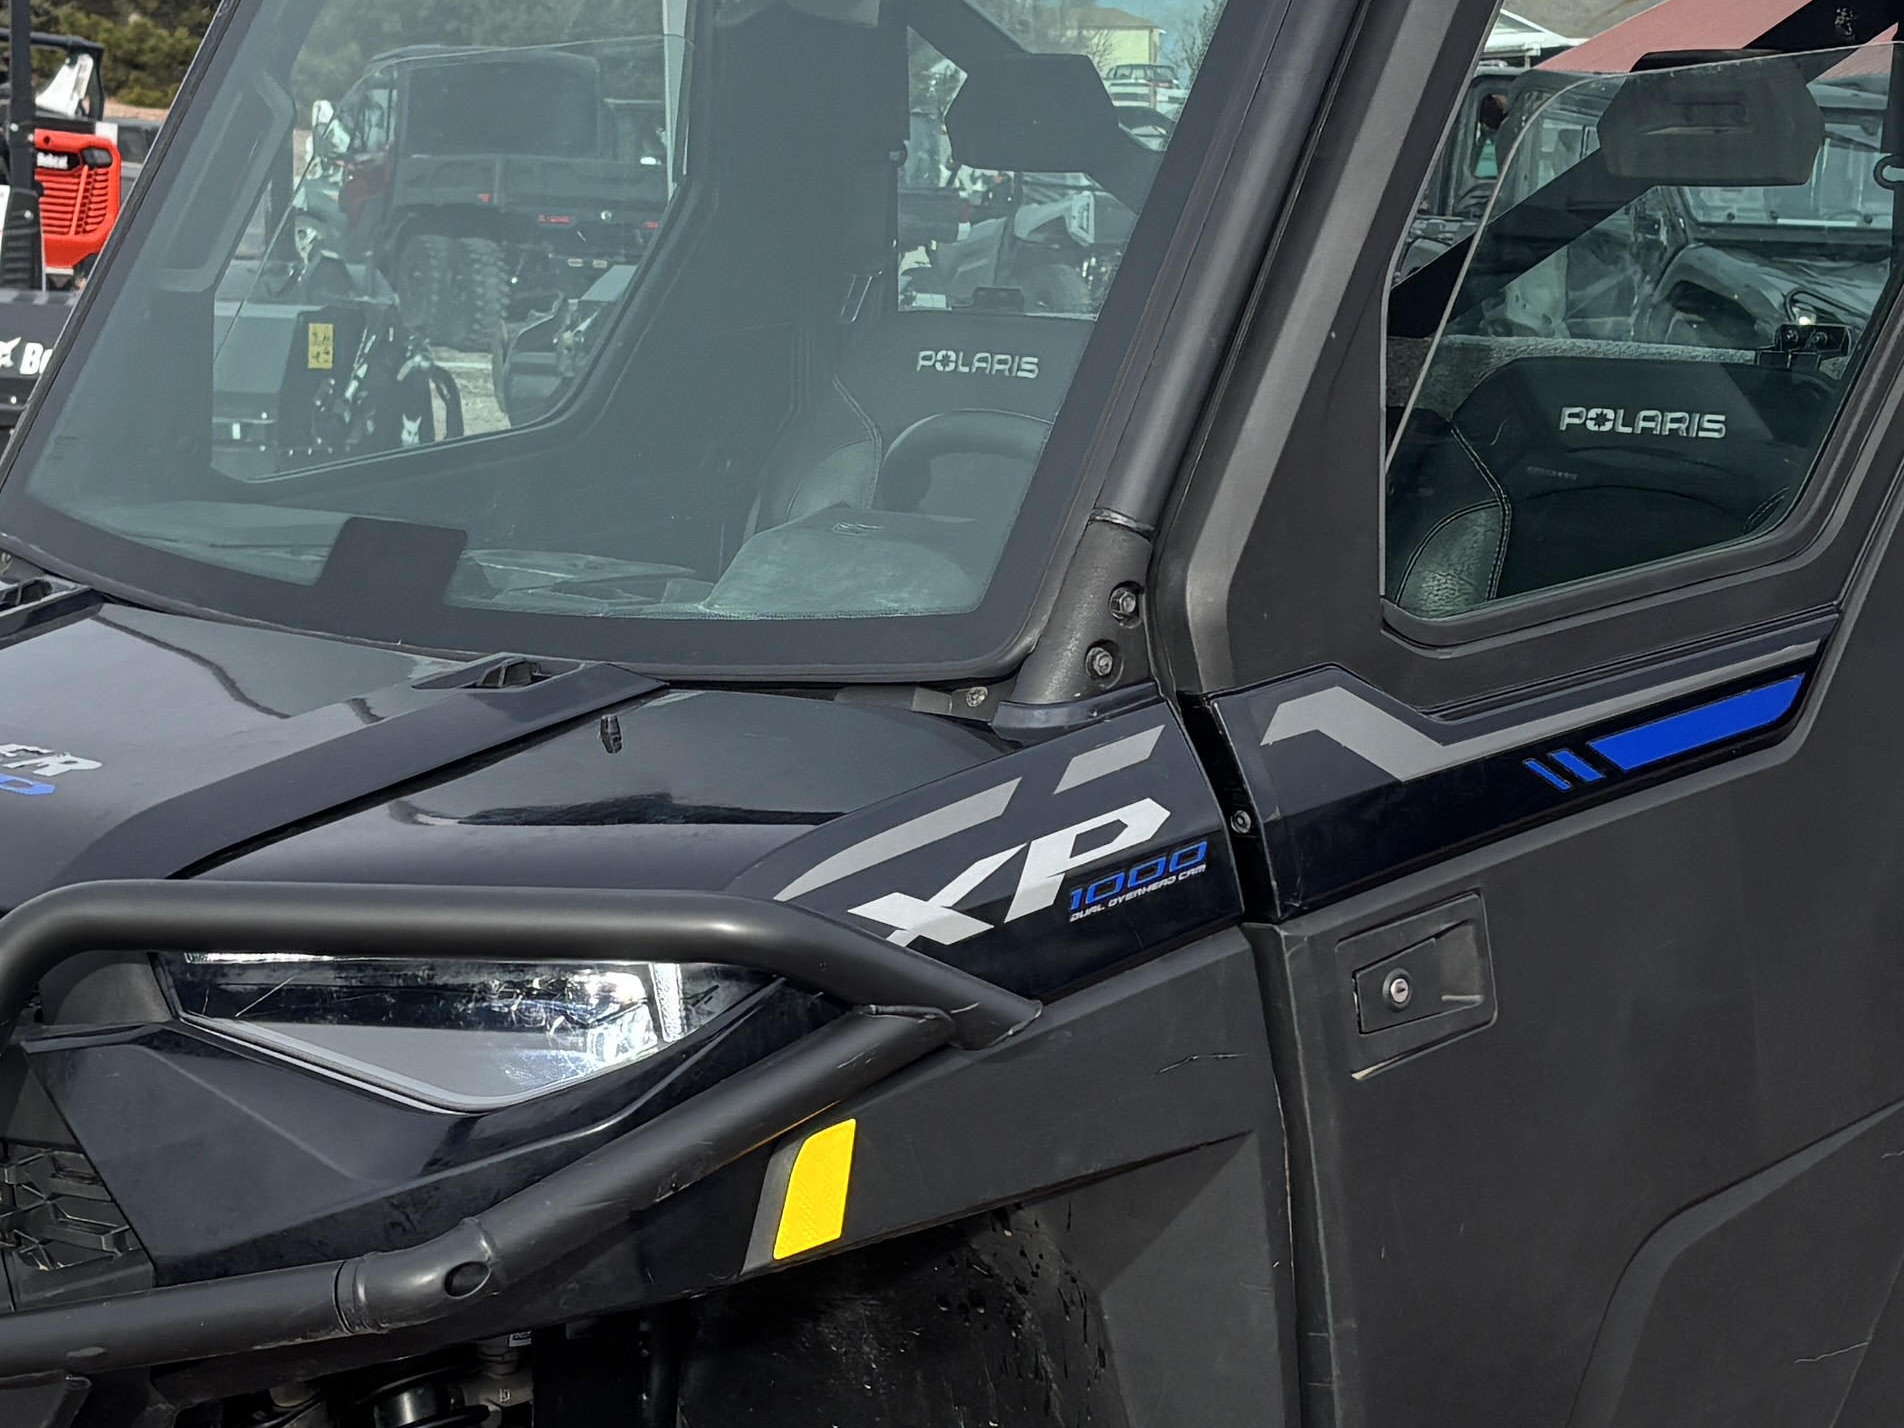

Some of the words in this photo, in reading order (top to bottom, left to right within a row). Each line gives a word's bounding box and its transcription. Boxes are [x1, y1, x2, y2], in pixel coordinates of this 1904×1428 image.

[916, 349, 1040, 379] POLARIS
[1559, 406, 1726, 439] POLARIS
[848, 798, 1171, 948] XP
[1069, 840, 1208, 911] 1000
[1069, 903, 1105, 923] DUAL
[1107, 874, 1177, 907] OVERHEAD
[1178, 863, 1207, 881] CAM
